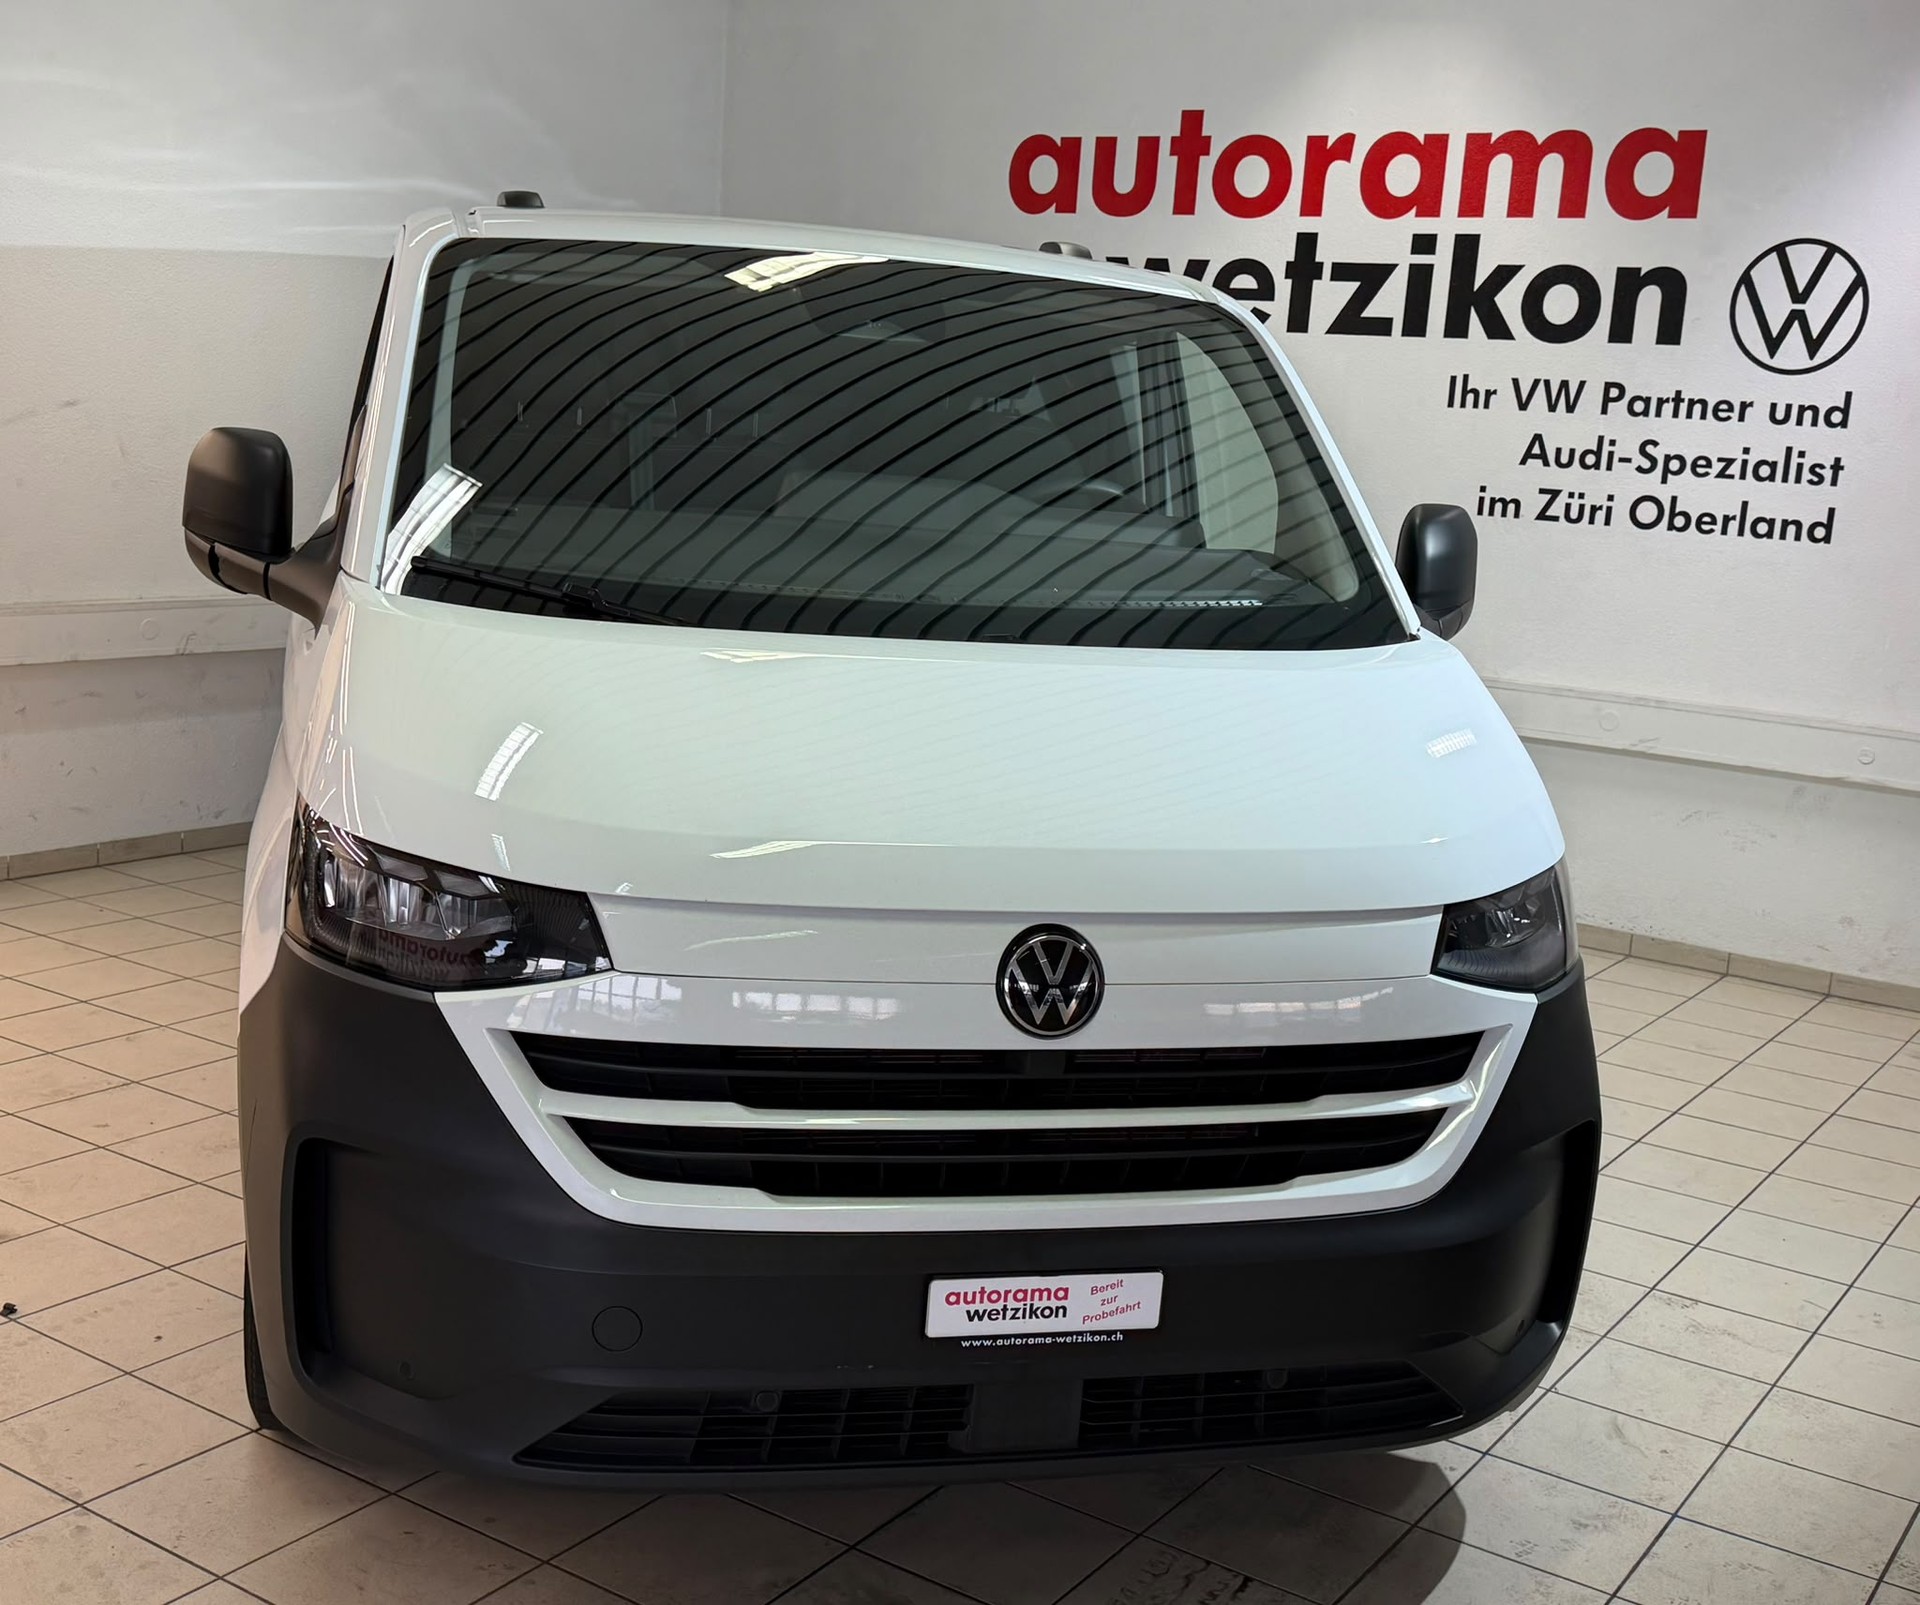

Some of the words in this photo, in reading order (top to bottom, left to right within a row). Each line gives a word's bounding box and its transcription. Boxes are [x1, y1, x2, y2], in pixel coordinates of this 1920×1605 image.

[1010, 110, 1708, 221] autorama
[1106, 232, 1687, 345] etzikon
[1448, 375, 1497, 410] Ihr
[1512, 378, 1587, 414] VW
[1600, 382, 1754, 423] Partner
[1769, 391, 1853, 429] und
[1519, 434, 1845, 488] Audi-Spezialist
[1477, 486, 1522, 519] im
[1534, 488, 1615, 527] Züri
[1628, 495, 1836, 545] Oberland
[944, 1286, 1070, 1306] autorama
[1089, 1278, 1125, 1296] Bereit
[966, 1302, 1068, 1323] wetzikon
[1082, 1300, 1142, 1325] Probefahrt
[1100, 1293, 1119, 1307] zur
[960, 1331, 1124, 1348] www.autorama-wetzikon.ch
